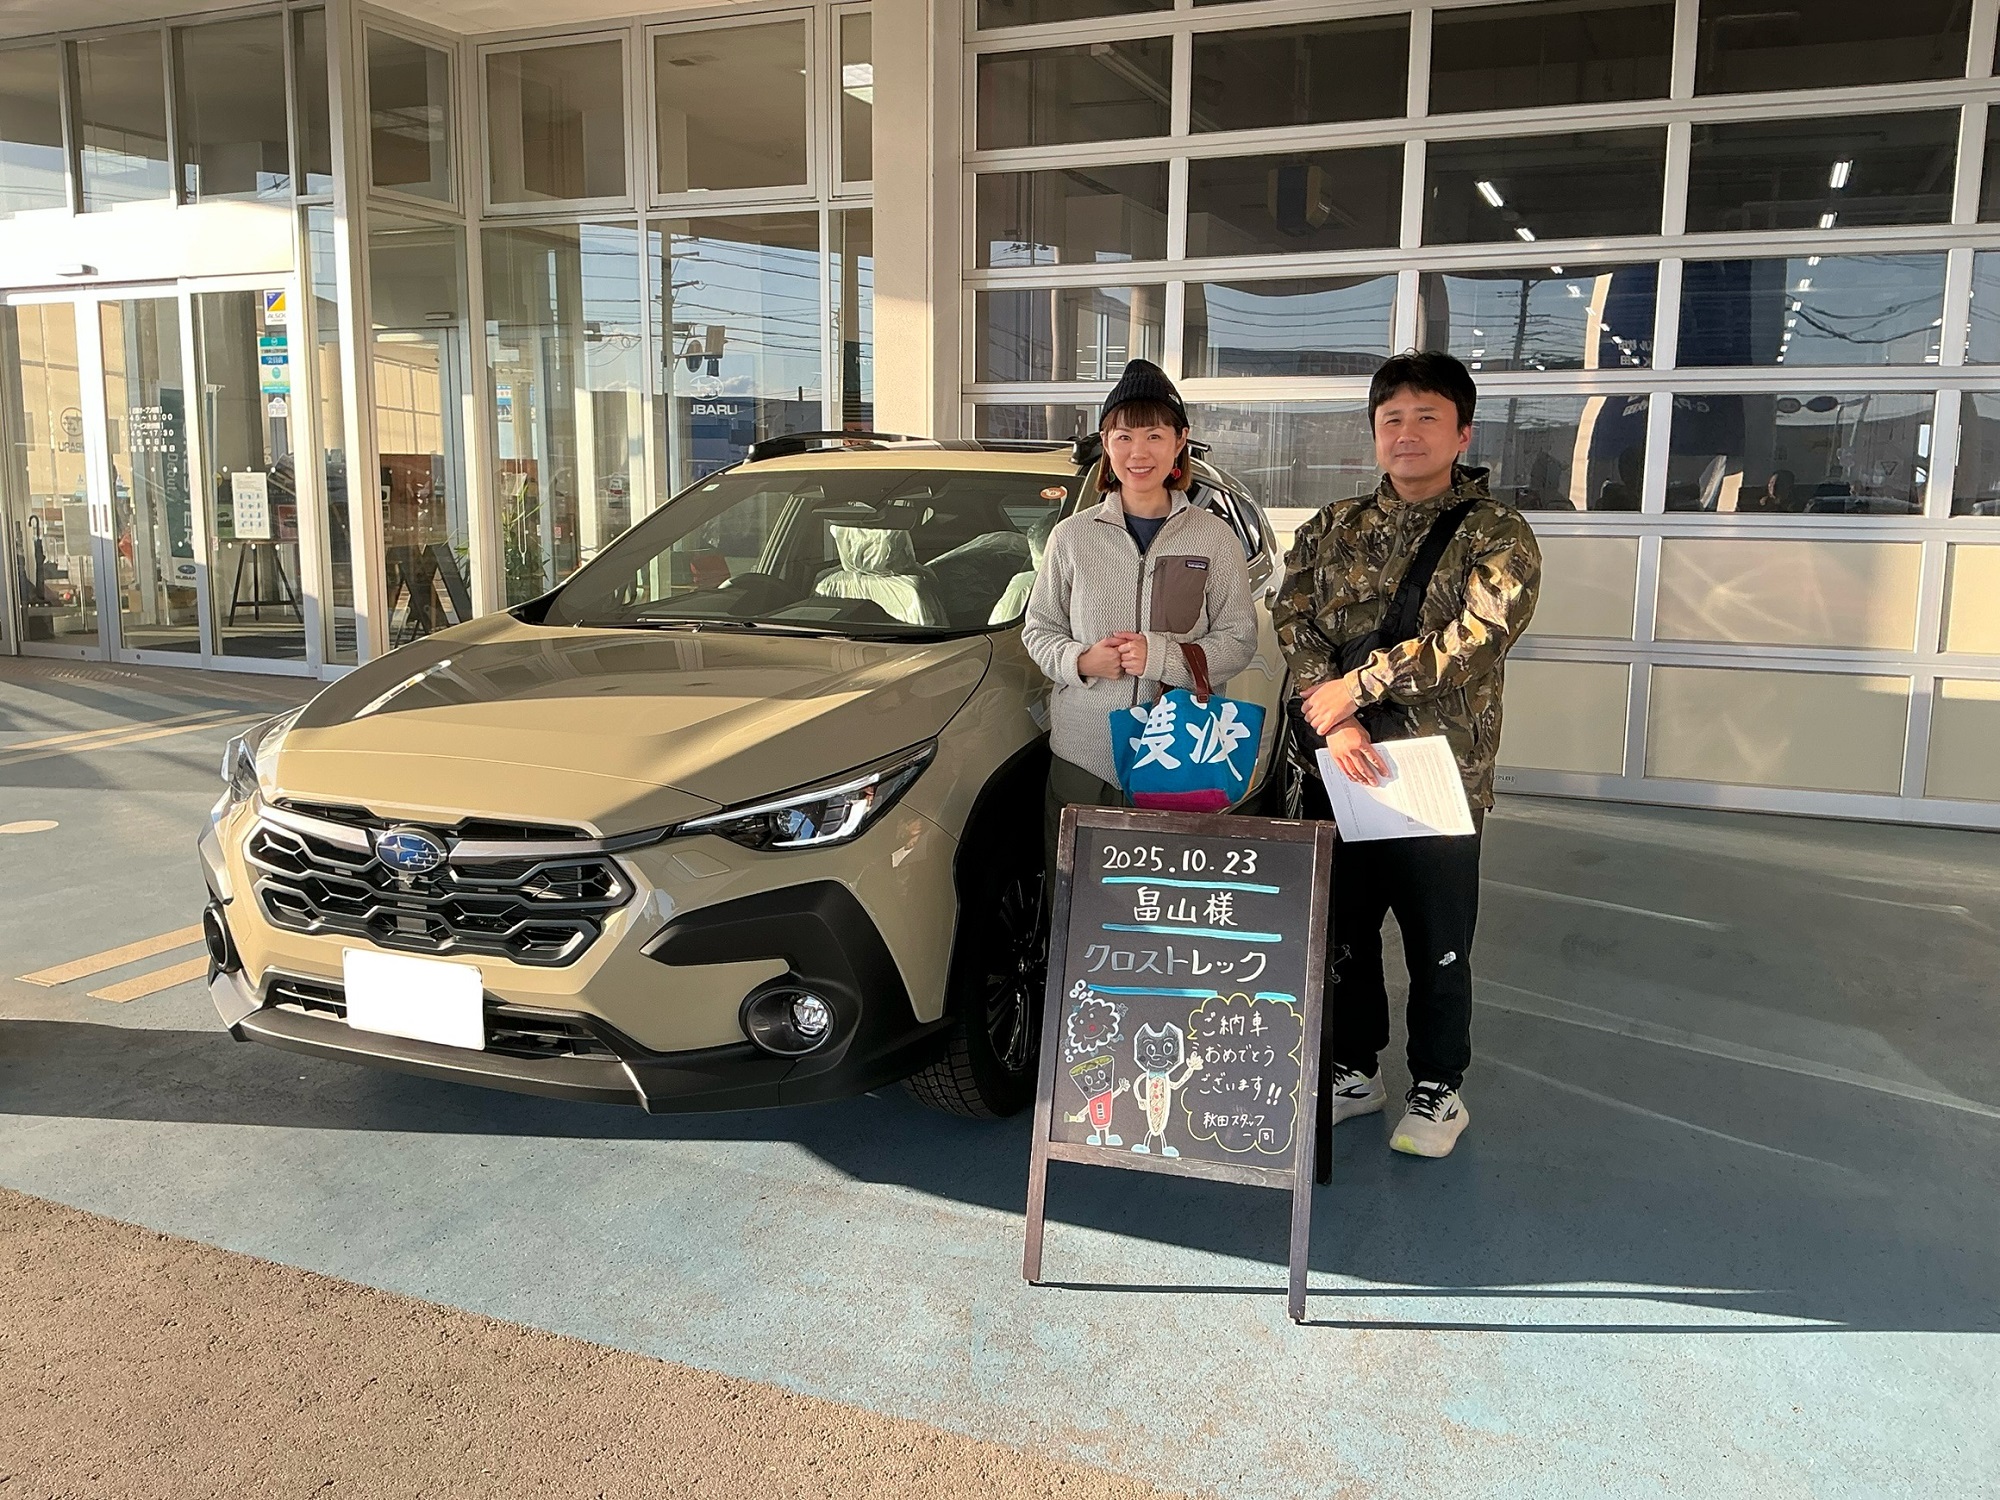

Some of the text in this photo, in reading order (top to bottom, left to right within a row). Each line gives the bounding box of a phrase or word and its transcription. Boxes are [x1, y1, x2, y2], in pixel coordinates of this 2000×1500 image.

[690, 403, 739, 416] BARU
[1102, 846, 1258, 875] 2025.10.23
[1133, 886, 1238, 926] 畠山様
[1084, 944, 1268, 983] クロストレック
[1202, 1010, 1269, 1037] ご納車
[1204, 1043, 1275, 1067] おめでとう
[1202, 1111, 1265, 1129] 秋田スタッフ
